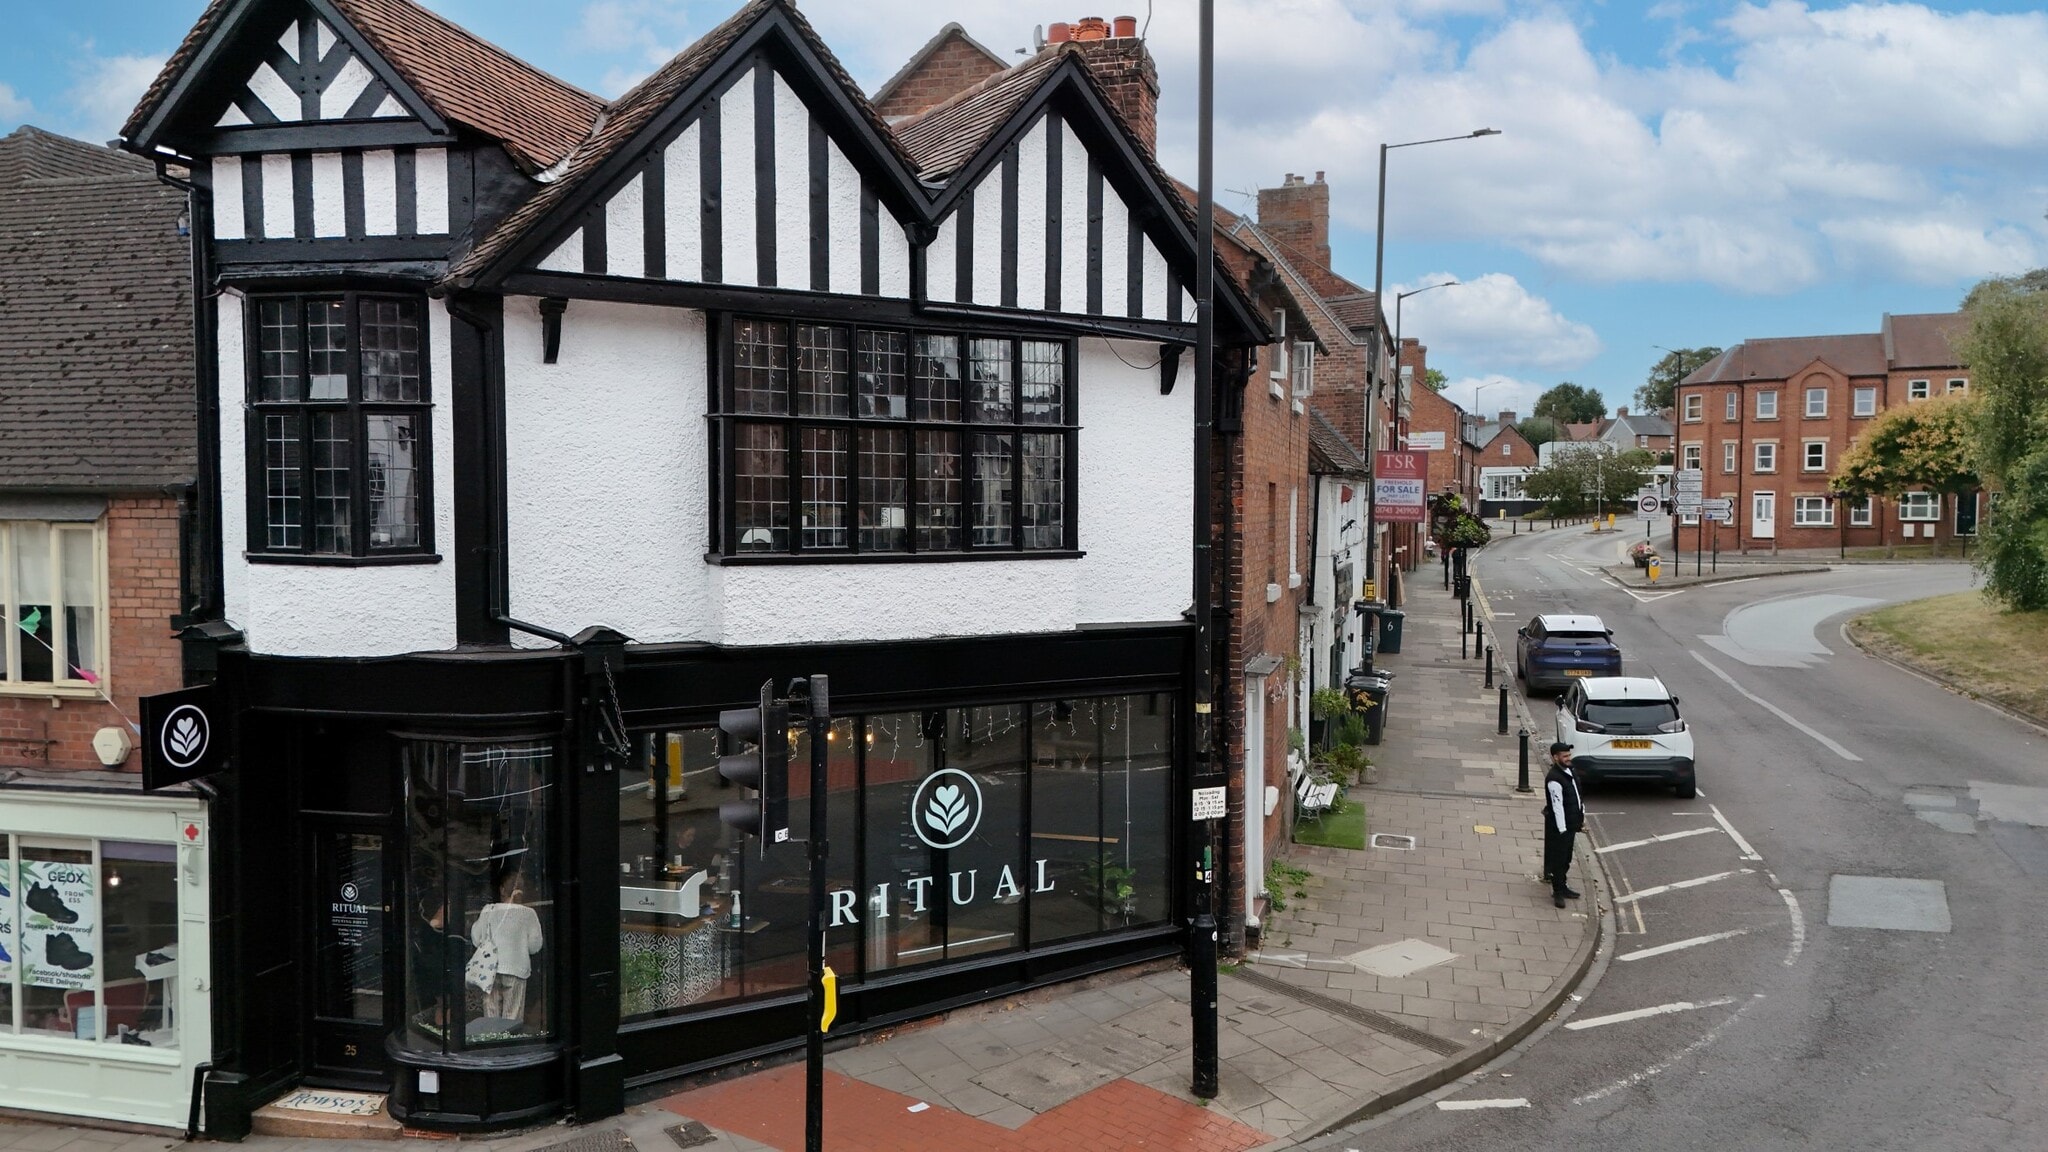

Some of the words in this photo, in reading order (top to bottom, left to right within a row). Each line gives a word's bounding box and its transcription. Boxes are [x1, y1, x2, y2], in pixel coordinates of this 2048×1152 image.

[1383, 454, 1416, 469] TSR
[1377, 485, 1396, 493] FOR
[1398, 486, 1420, 494] SALE
[1387, 621, 1394, 632] 6
[48, 871, 85, 883] GEOX
[829, 859, 1055, 927] RITUAL
[332, 903, 368, 914] RITUAL
[344, 1045, 357, 1056] 25
